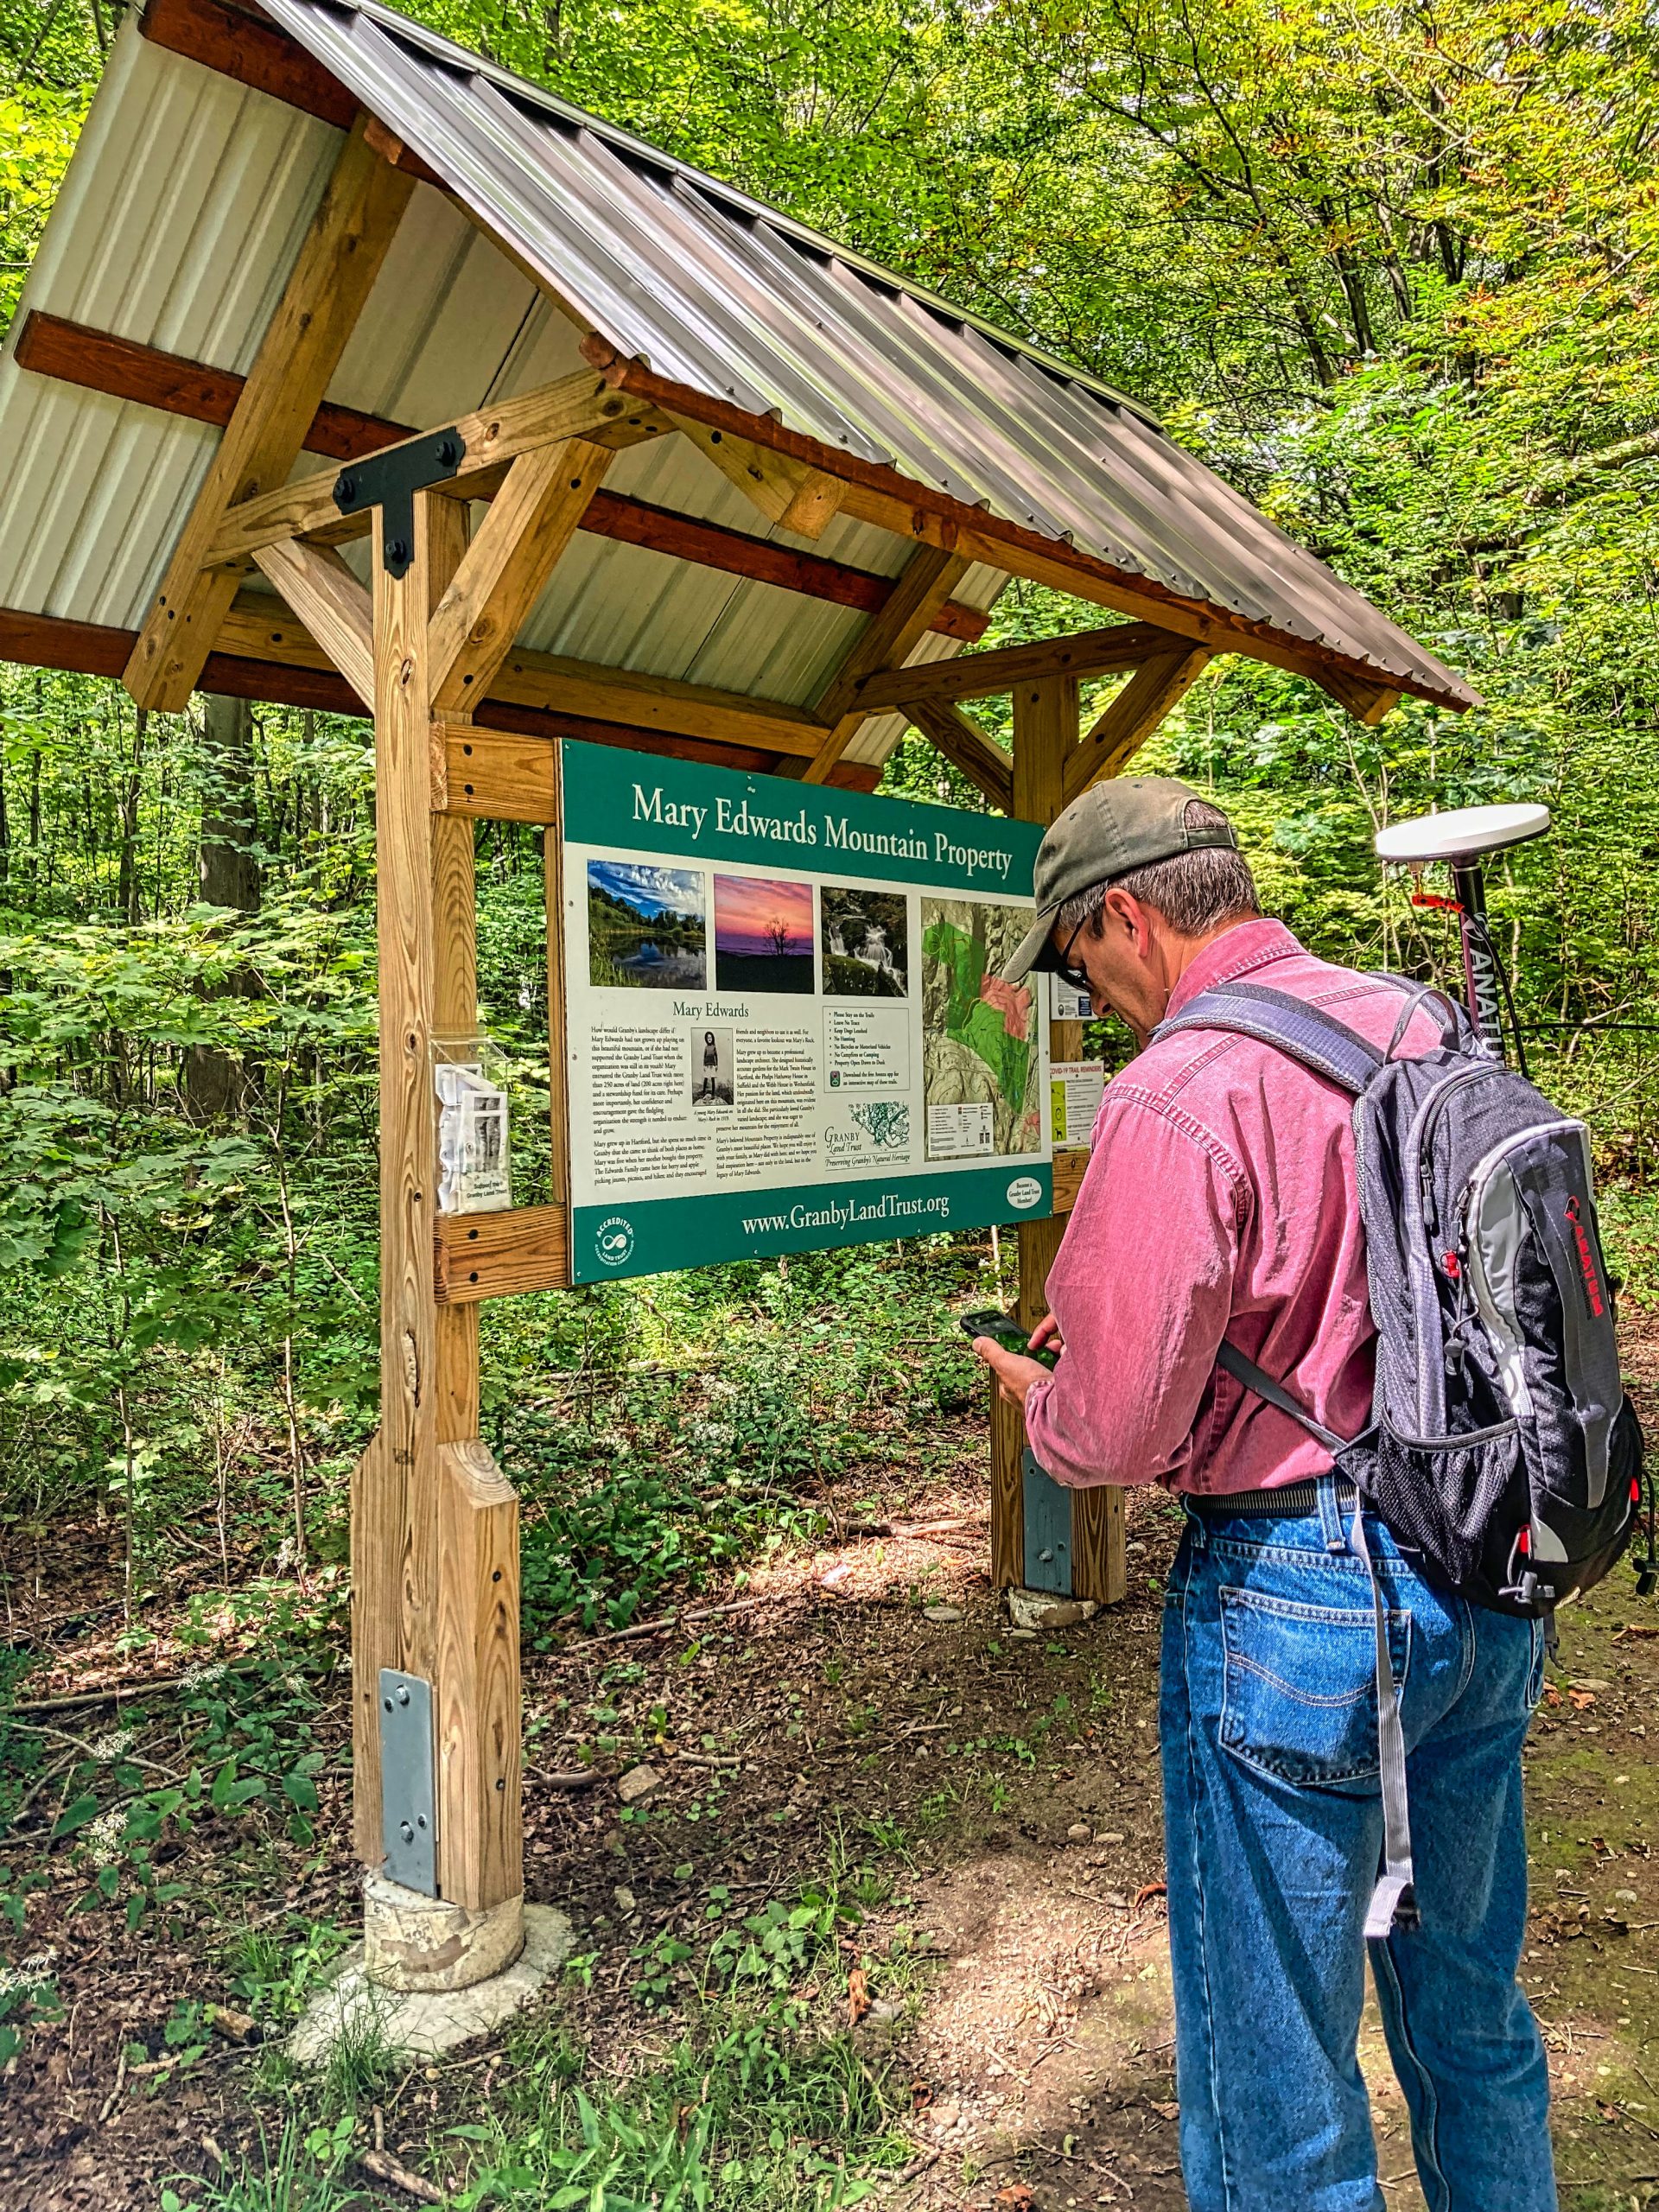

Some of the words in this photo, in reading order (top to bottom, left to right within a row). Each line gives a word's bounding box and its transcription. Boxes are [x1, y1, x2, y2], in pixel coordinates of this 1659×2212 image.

[632, 783, 708, 840] Mary
[715, 797, 817, 845] Edwards
[824, 815, 929, 861] Mountain
[934, 832, 1013, 880] Property
[673, 1001, 702, 1020] Mary
[706, 1002, 749, 1017] Edwards
[830, 1142, 845, 1155] Land
[847, 1142, 862, 1151] Trust
[825, 1157, 851, 1168] Preserving
[852, 1156, 871, 1166] Granby's
[890, 1153, 910, 1163] Heritage
[741, 1194, 950, 1235] www.GranbyLandTrust.org
[596, 1217, 633, 1238] ACCREDITED
[602, 1252, 614, 1261] LAND
[615, 1249, 627, 1260] TRUST
